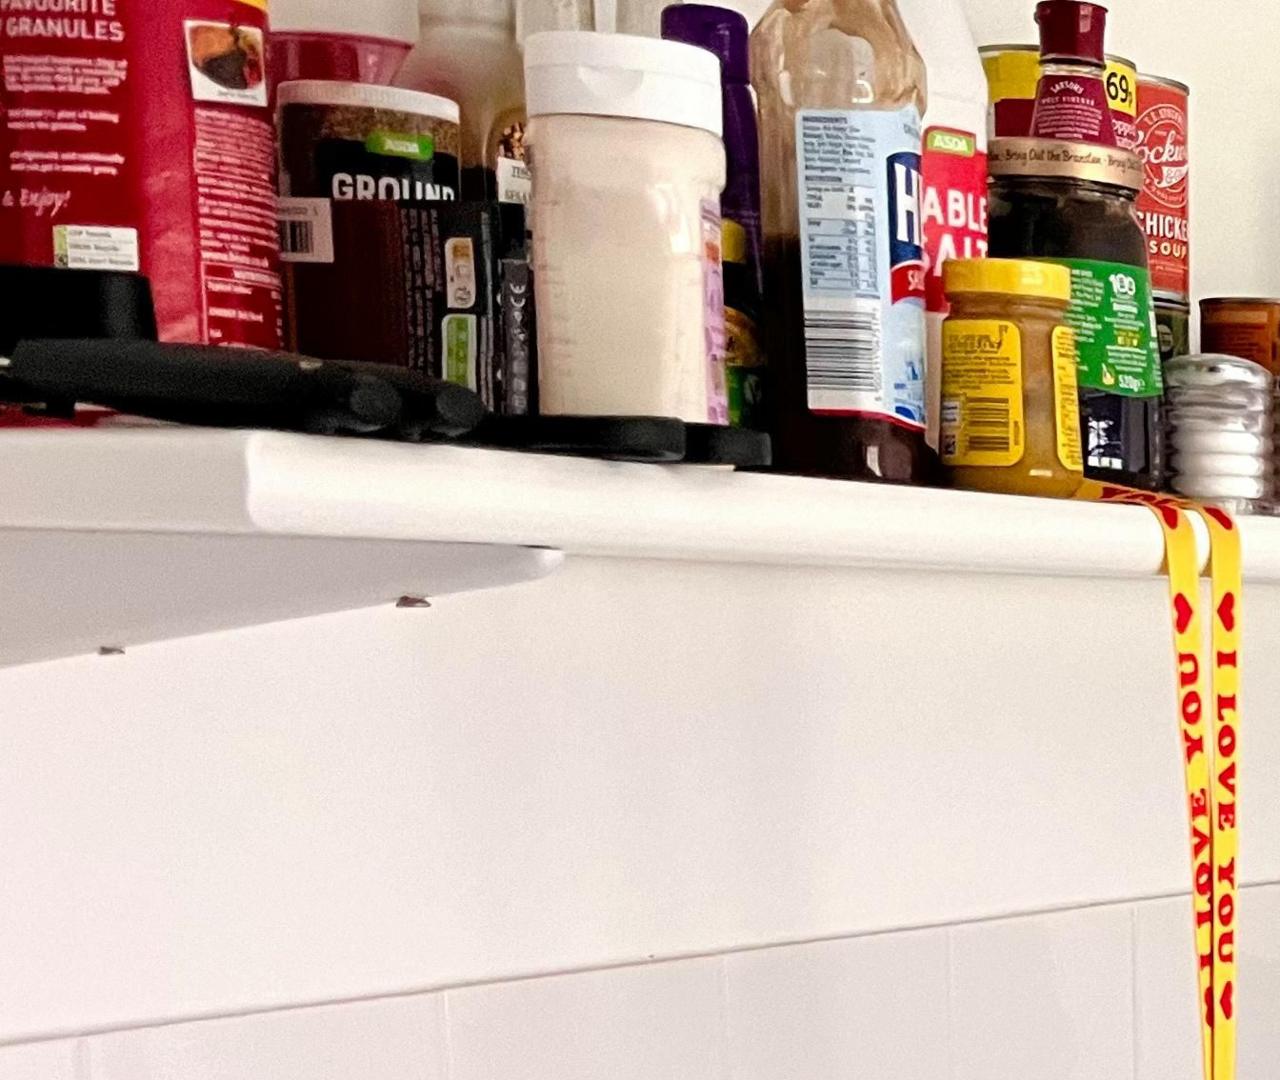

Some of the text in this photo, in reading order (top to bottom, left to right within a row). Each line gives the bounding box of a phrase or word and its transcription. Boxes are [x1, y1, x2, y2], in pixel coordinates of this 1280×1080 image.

[6, 17, 125, 41] GRANULES
[932, 132, 969, 153] ASDA
[332, 172, 455, 201] GROUND
[924, 186, 988, 234] ABLE
[1178, 652, 1204, 765] YOU
[1217, 650, 1236, 964] I LOVE YOU
[1190, 788, 1213, 929] LOVE
